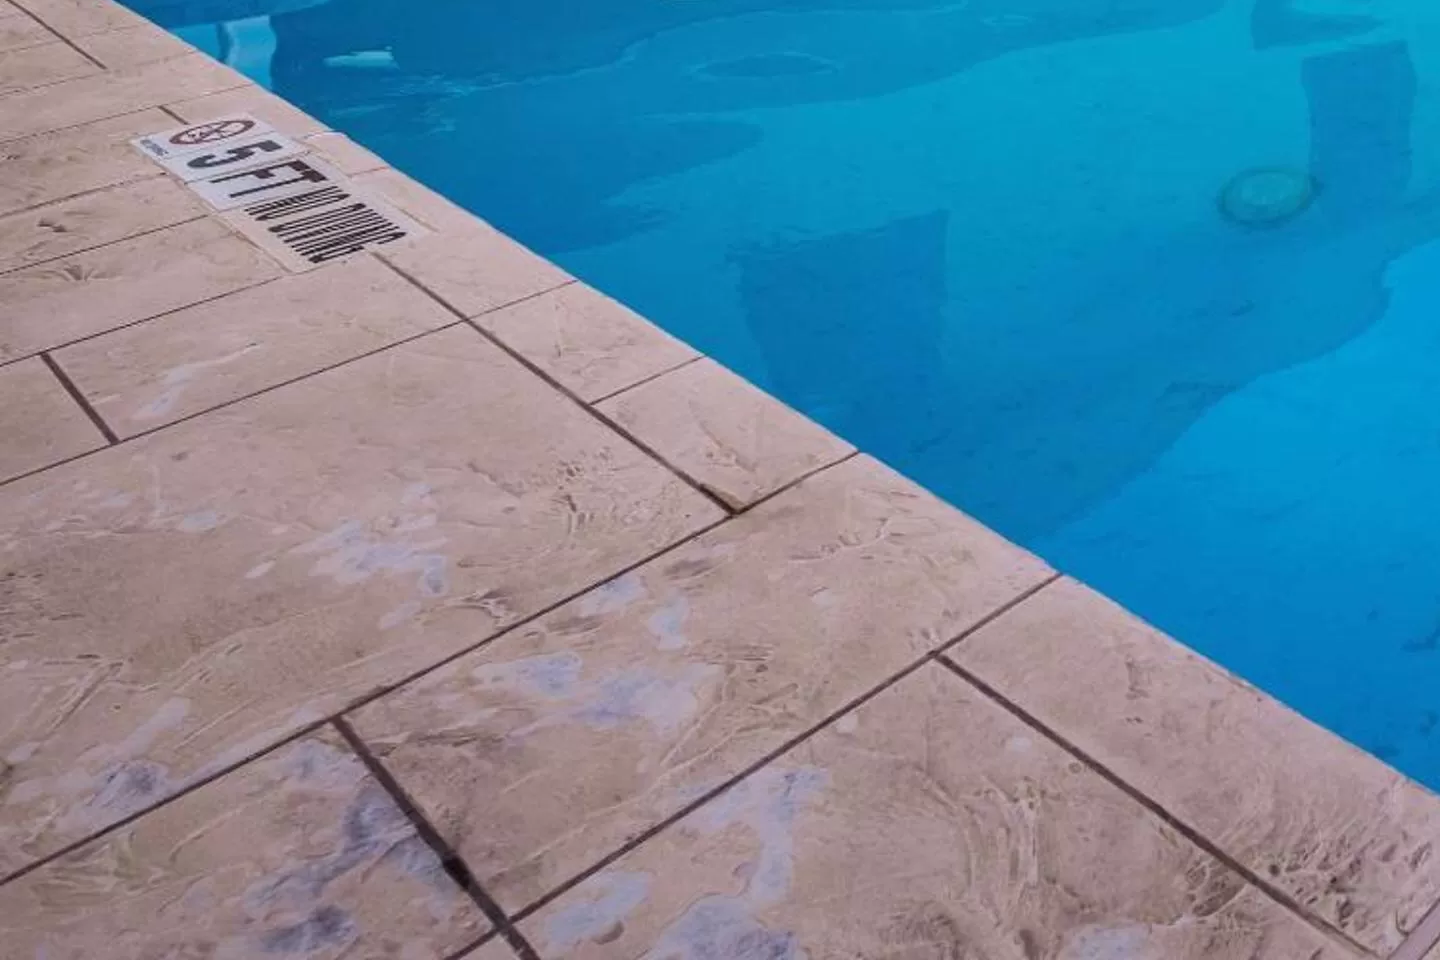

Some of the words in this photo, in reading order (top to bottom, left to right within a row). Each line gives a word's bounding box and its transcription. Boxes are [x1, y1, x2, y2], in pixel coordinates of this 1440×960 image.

[186, 139, 283, 169] 5
[208, 159, 328, 198] FT
[243, 185, 350, 221] NO
[267, 202, 406, 263] DIVING
